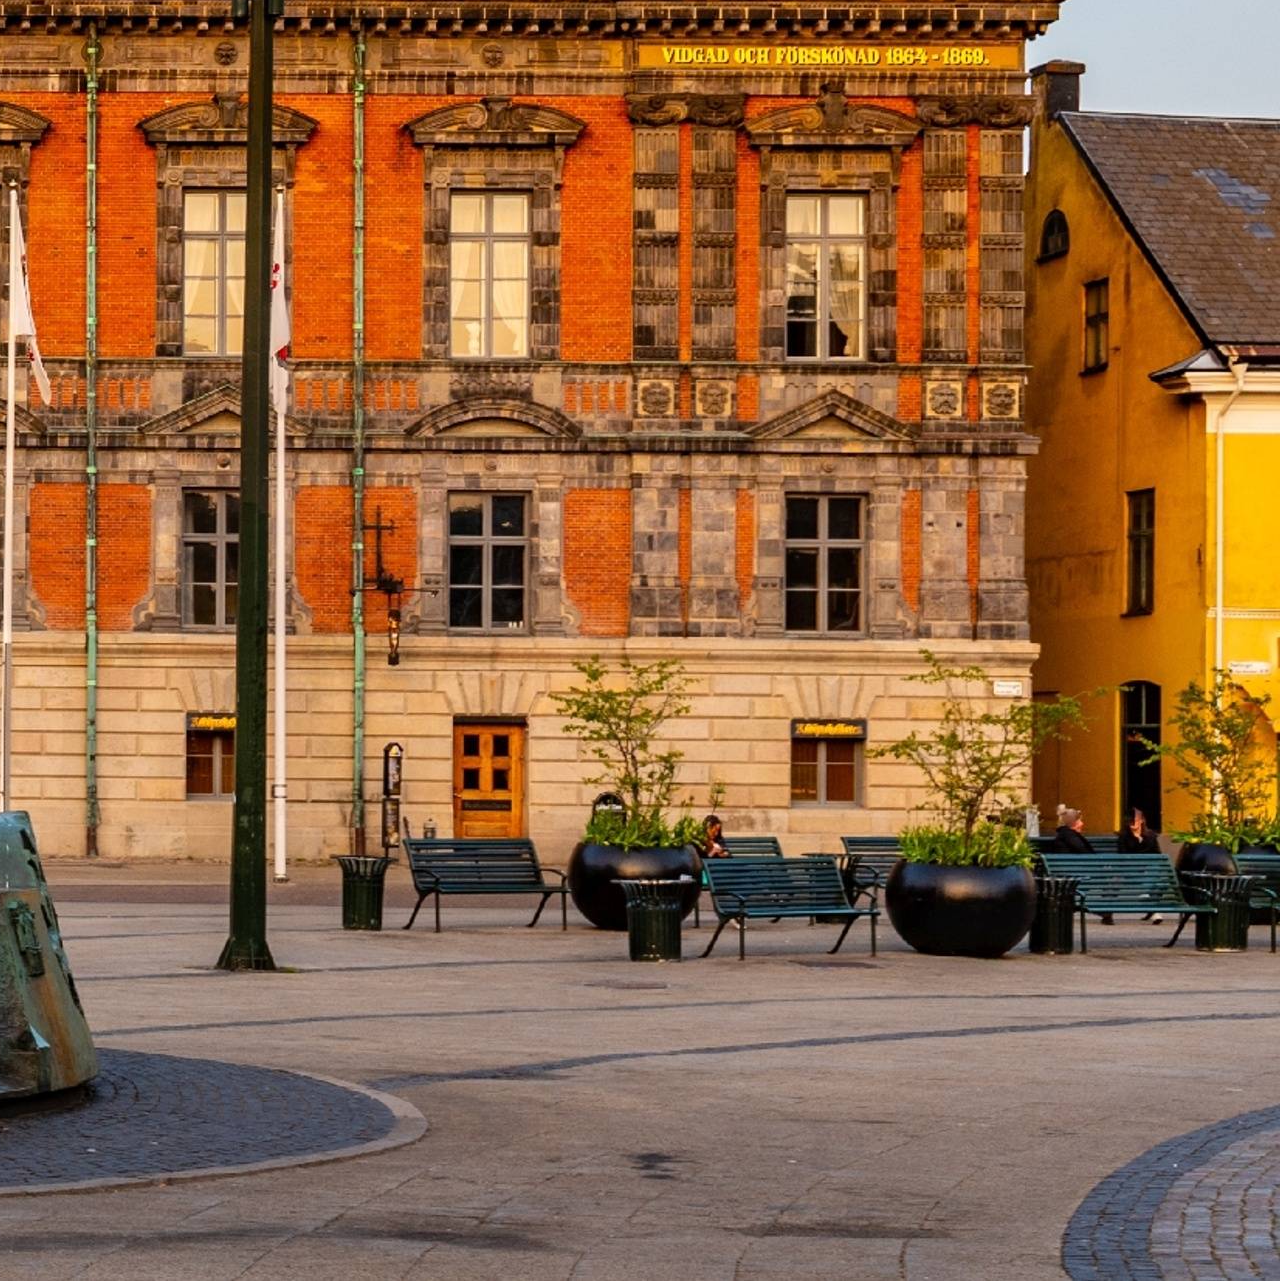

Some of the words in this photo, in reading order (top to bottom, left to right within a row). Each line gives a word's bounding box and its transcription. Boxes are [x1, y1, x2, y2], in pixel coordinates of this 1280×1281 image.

[662, 46, 730, 64] VIDGAD
[734, 47, 770, 64] OCH
[775, 45, 881, 65] FÖRSKÖNAD
[885, 47, 928, 65] 1864
